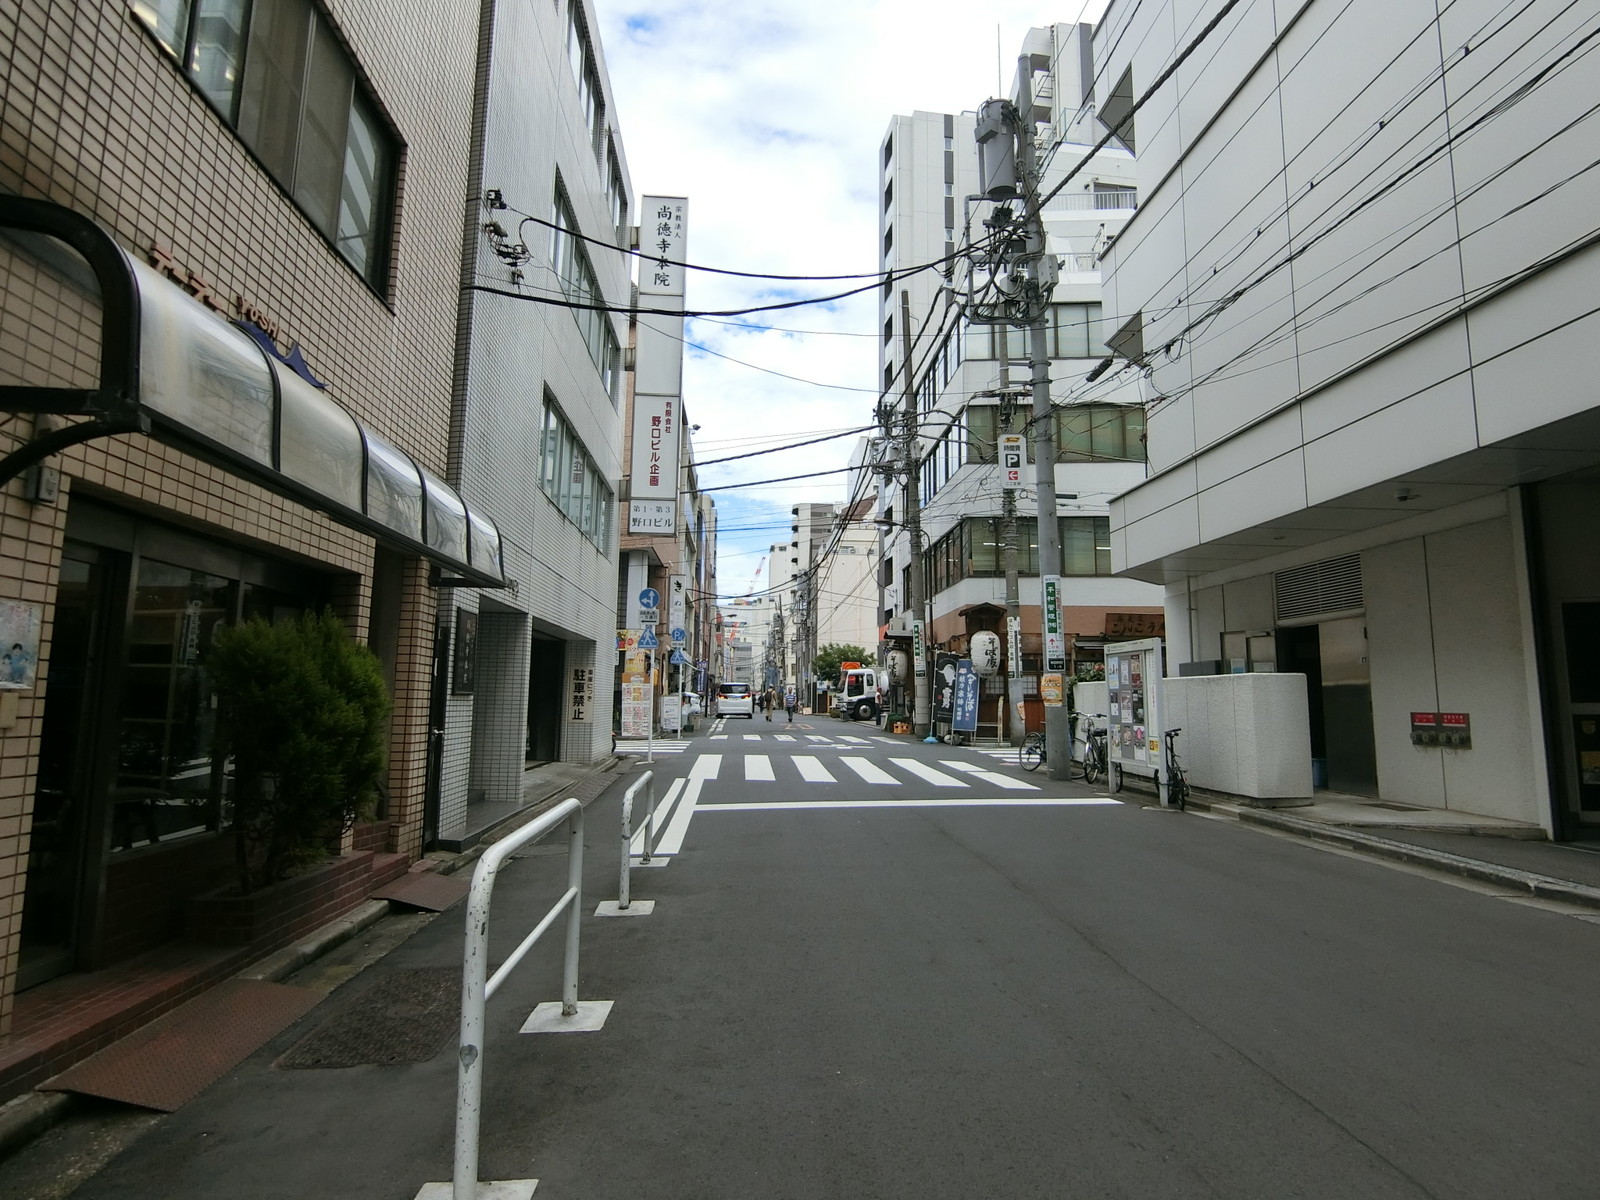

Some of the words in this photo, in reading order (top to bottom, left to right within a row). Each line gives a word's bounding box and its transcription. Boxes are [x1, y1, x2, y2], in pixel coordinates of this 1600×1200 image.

[674, 206, 682, 239] 宗教法人
[654, 205, 672, 287] 尚徳寺本院
[664, 401, 672, 434] 有限会社
[649, 416, 662, 487] 野口ビル企画
[1007, 455, 1018, 467] P
[631, 517, 673, 529] 野口ビル
[572, 669, 586, 721] 駐車禁止
